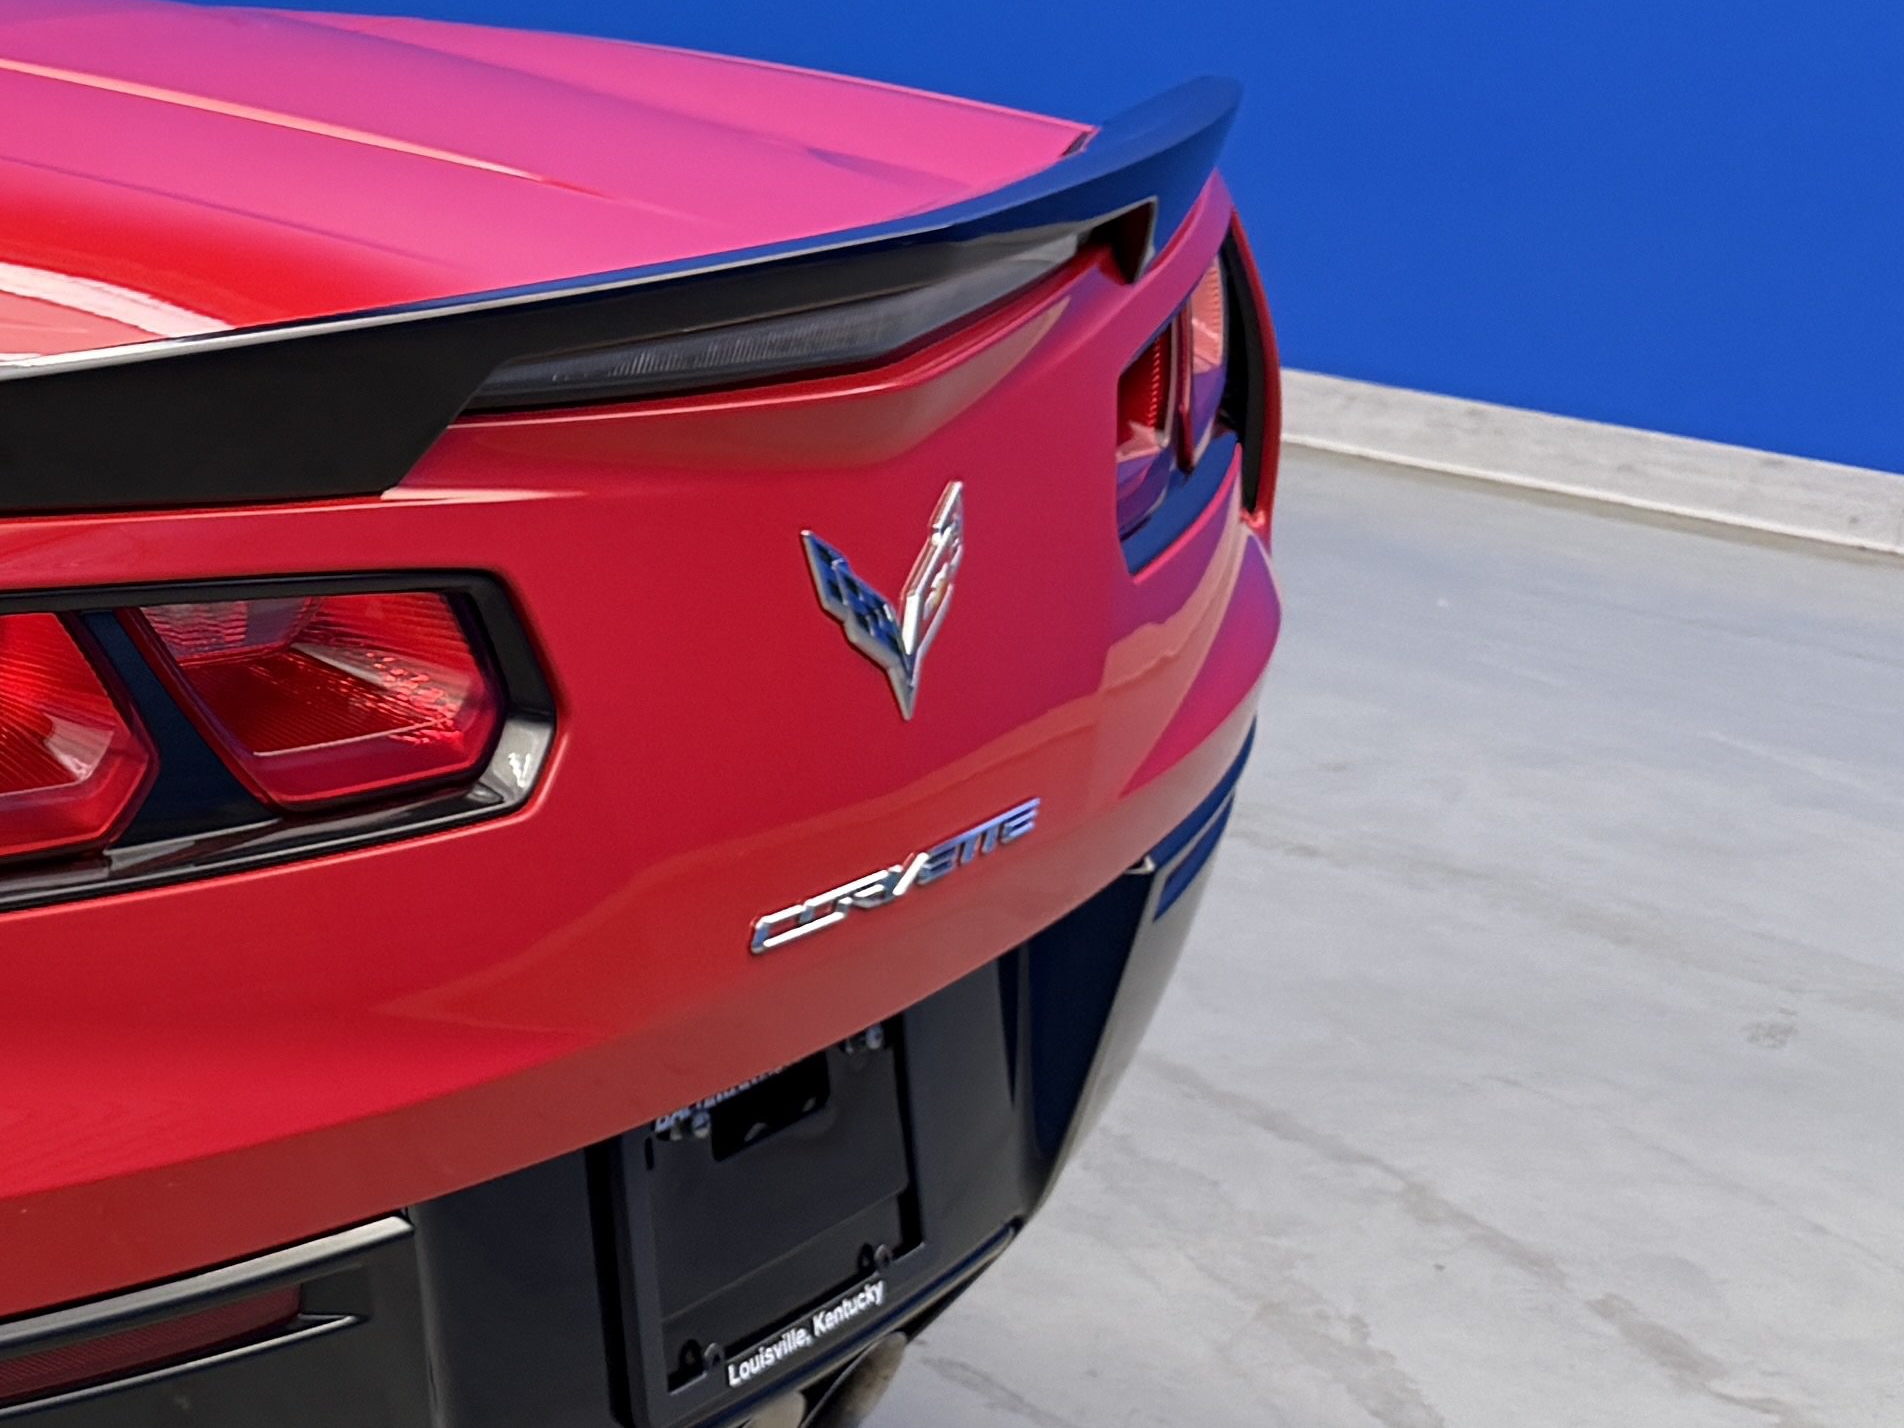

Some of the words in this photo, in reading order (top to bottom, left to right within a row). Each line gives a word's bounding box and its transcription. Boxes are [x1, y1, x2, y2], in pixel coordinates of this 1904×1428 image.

[749, 797, 1041, 954] CORVETTE
[727, 1327, 812, 1388] Louisville,
[812, 1280, 885, 1337] Kentucky
